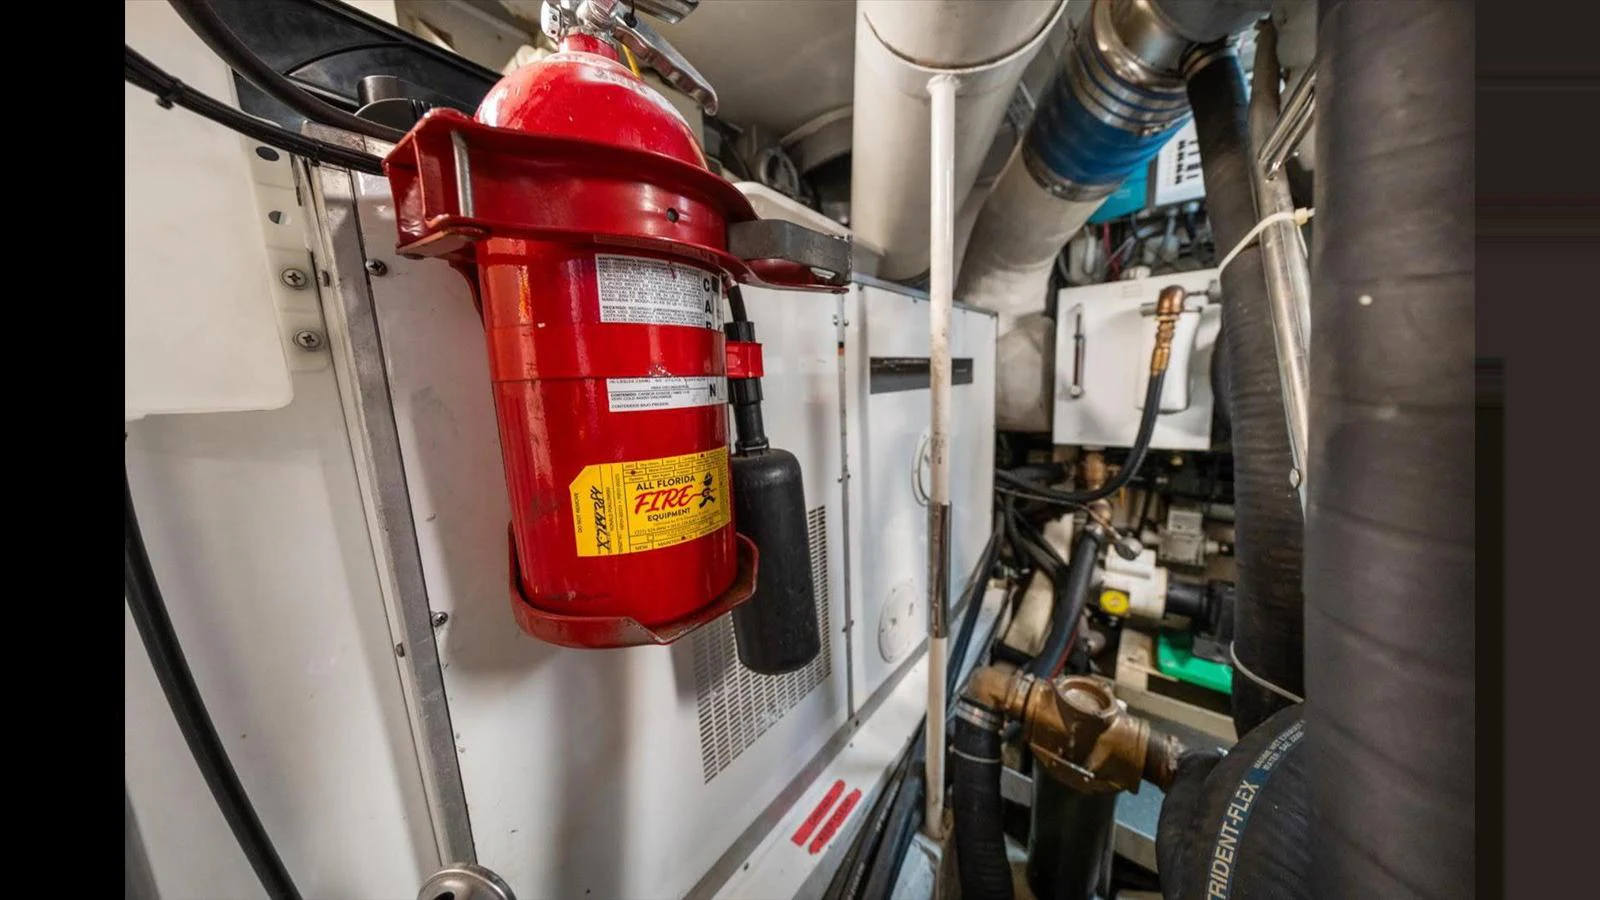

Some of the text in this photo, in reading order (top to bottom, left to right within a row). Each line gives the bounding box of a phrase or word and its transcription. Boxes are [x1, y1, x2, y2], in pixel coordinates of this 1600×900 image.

[709, 383, 717, 397] N
[636, 475, 696, 491] ALL FLORIDA
[634, 485, 694, 515] FIRE
[647, 507, 691, 522] EQUIPMENT
[1207, 780, 1260, 900] TRIDENT-FLEX
